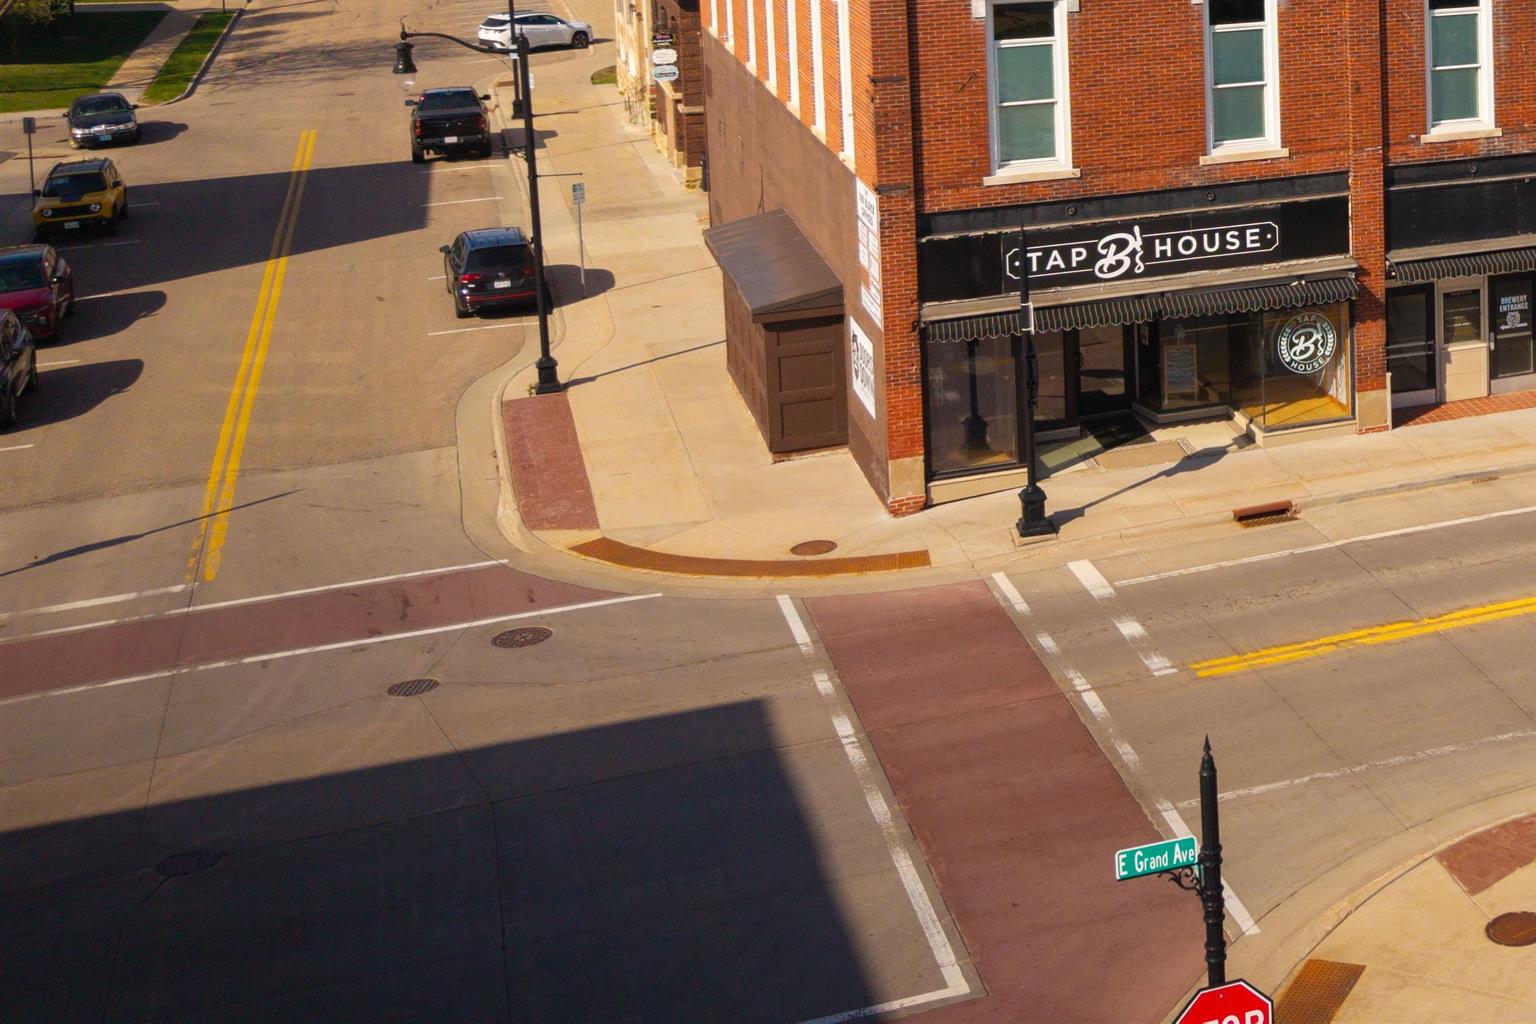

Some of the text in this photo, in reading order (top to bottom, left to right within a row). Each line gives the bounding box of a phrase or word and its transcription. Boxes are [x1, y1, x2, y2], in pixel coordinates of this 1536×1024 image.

[1026, 247, 1088, 273] TAP
[1154, 228, 1261, 259] HOUSE
[1500, 295, 1527, 305] BREWERY
[1499, 302, 1529, 313] ENTRANCE
[1297, 315, 1317, 324] TAP
[1290, 357, 1325, 371] HOUSE
[1118, 843, 1195, 876] E Grand Ave
